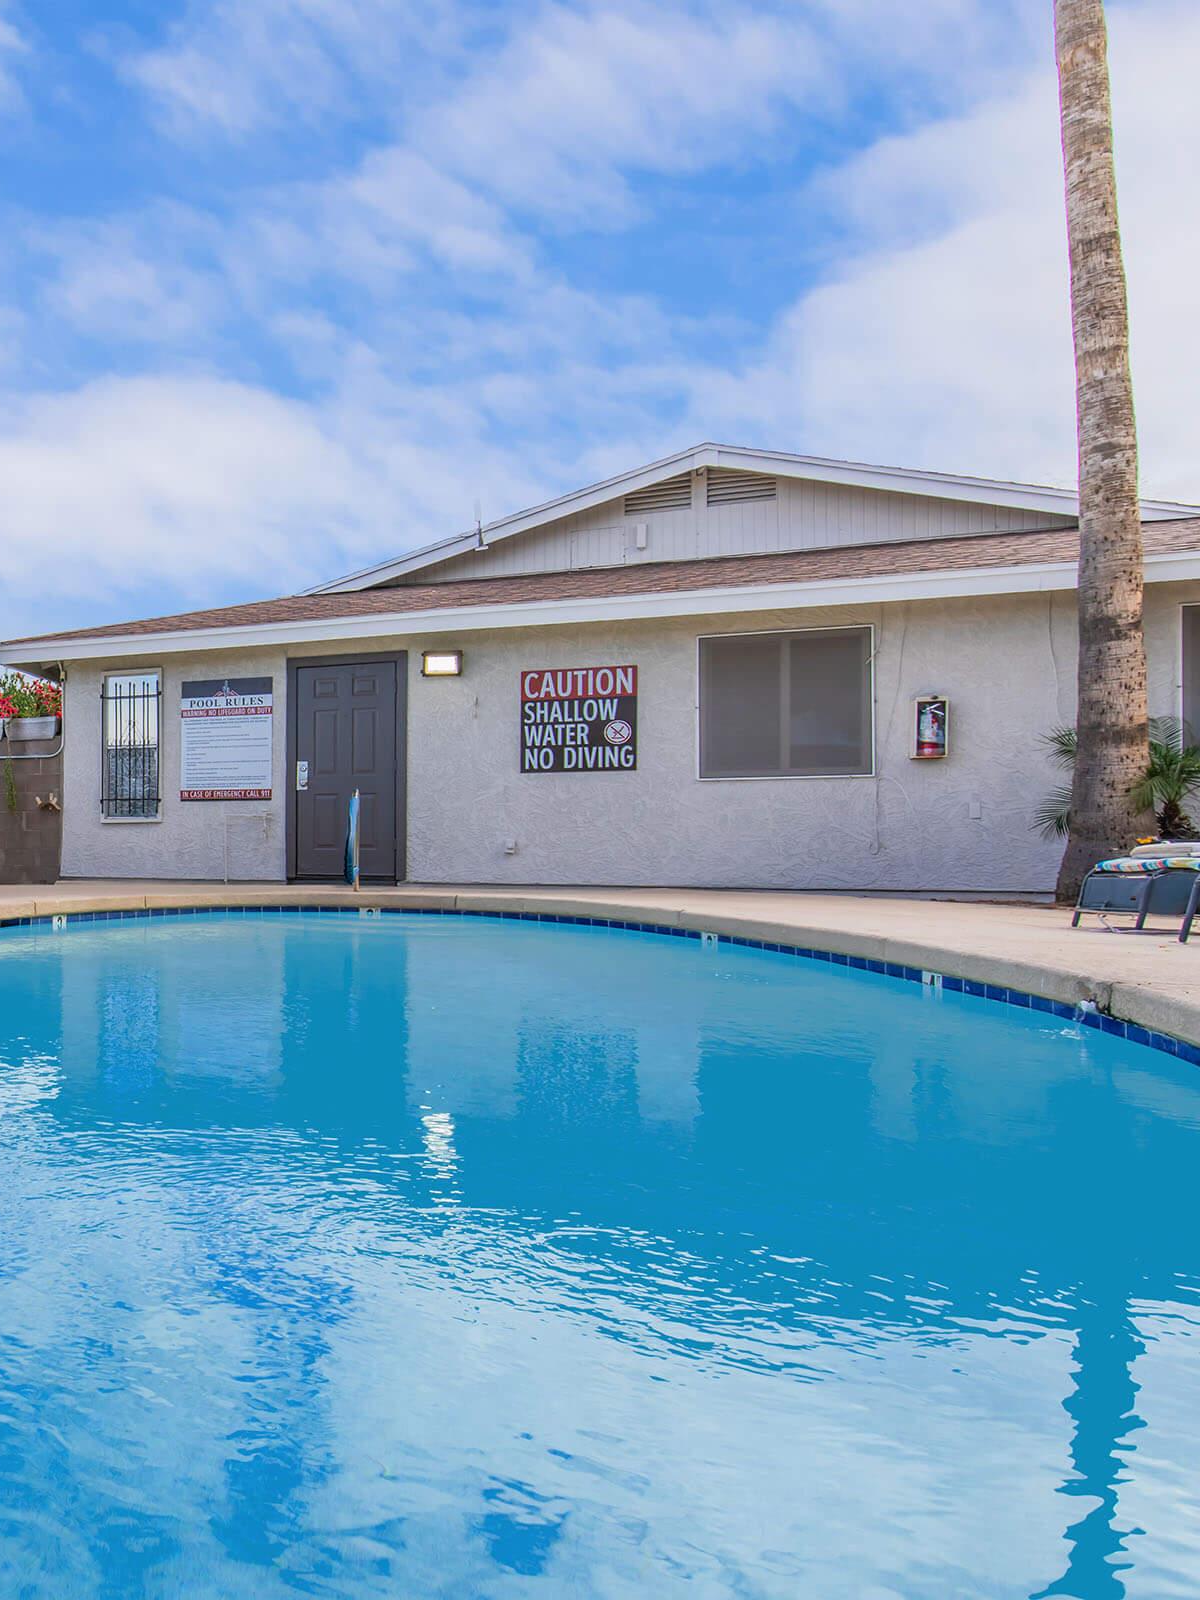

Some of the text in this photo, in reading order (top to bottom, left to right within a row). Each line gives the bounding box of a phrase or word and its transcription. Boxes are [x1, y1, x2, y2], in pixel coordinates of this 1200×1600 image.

[524, 667, 633, 698] CAUTION
[182, 705, 272, 717] WARNING NO LIFEGUARD ON DUTY
[190, 696, 264, 708] POOL RULES
[524, 698, 618, 724] SHALLOW
[524, 723, 590, 746] WATER
[525, 745, 635, 770] NO DIVING
[182, 789, 270, 799] IN CASE OF EMERGENCY CALL 911
